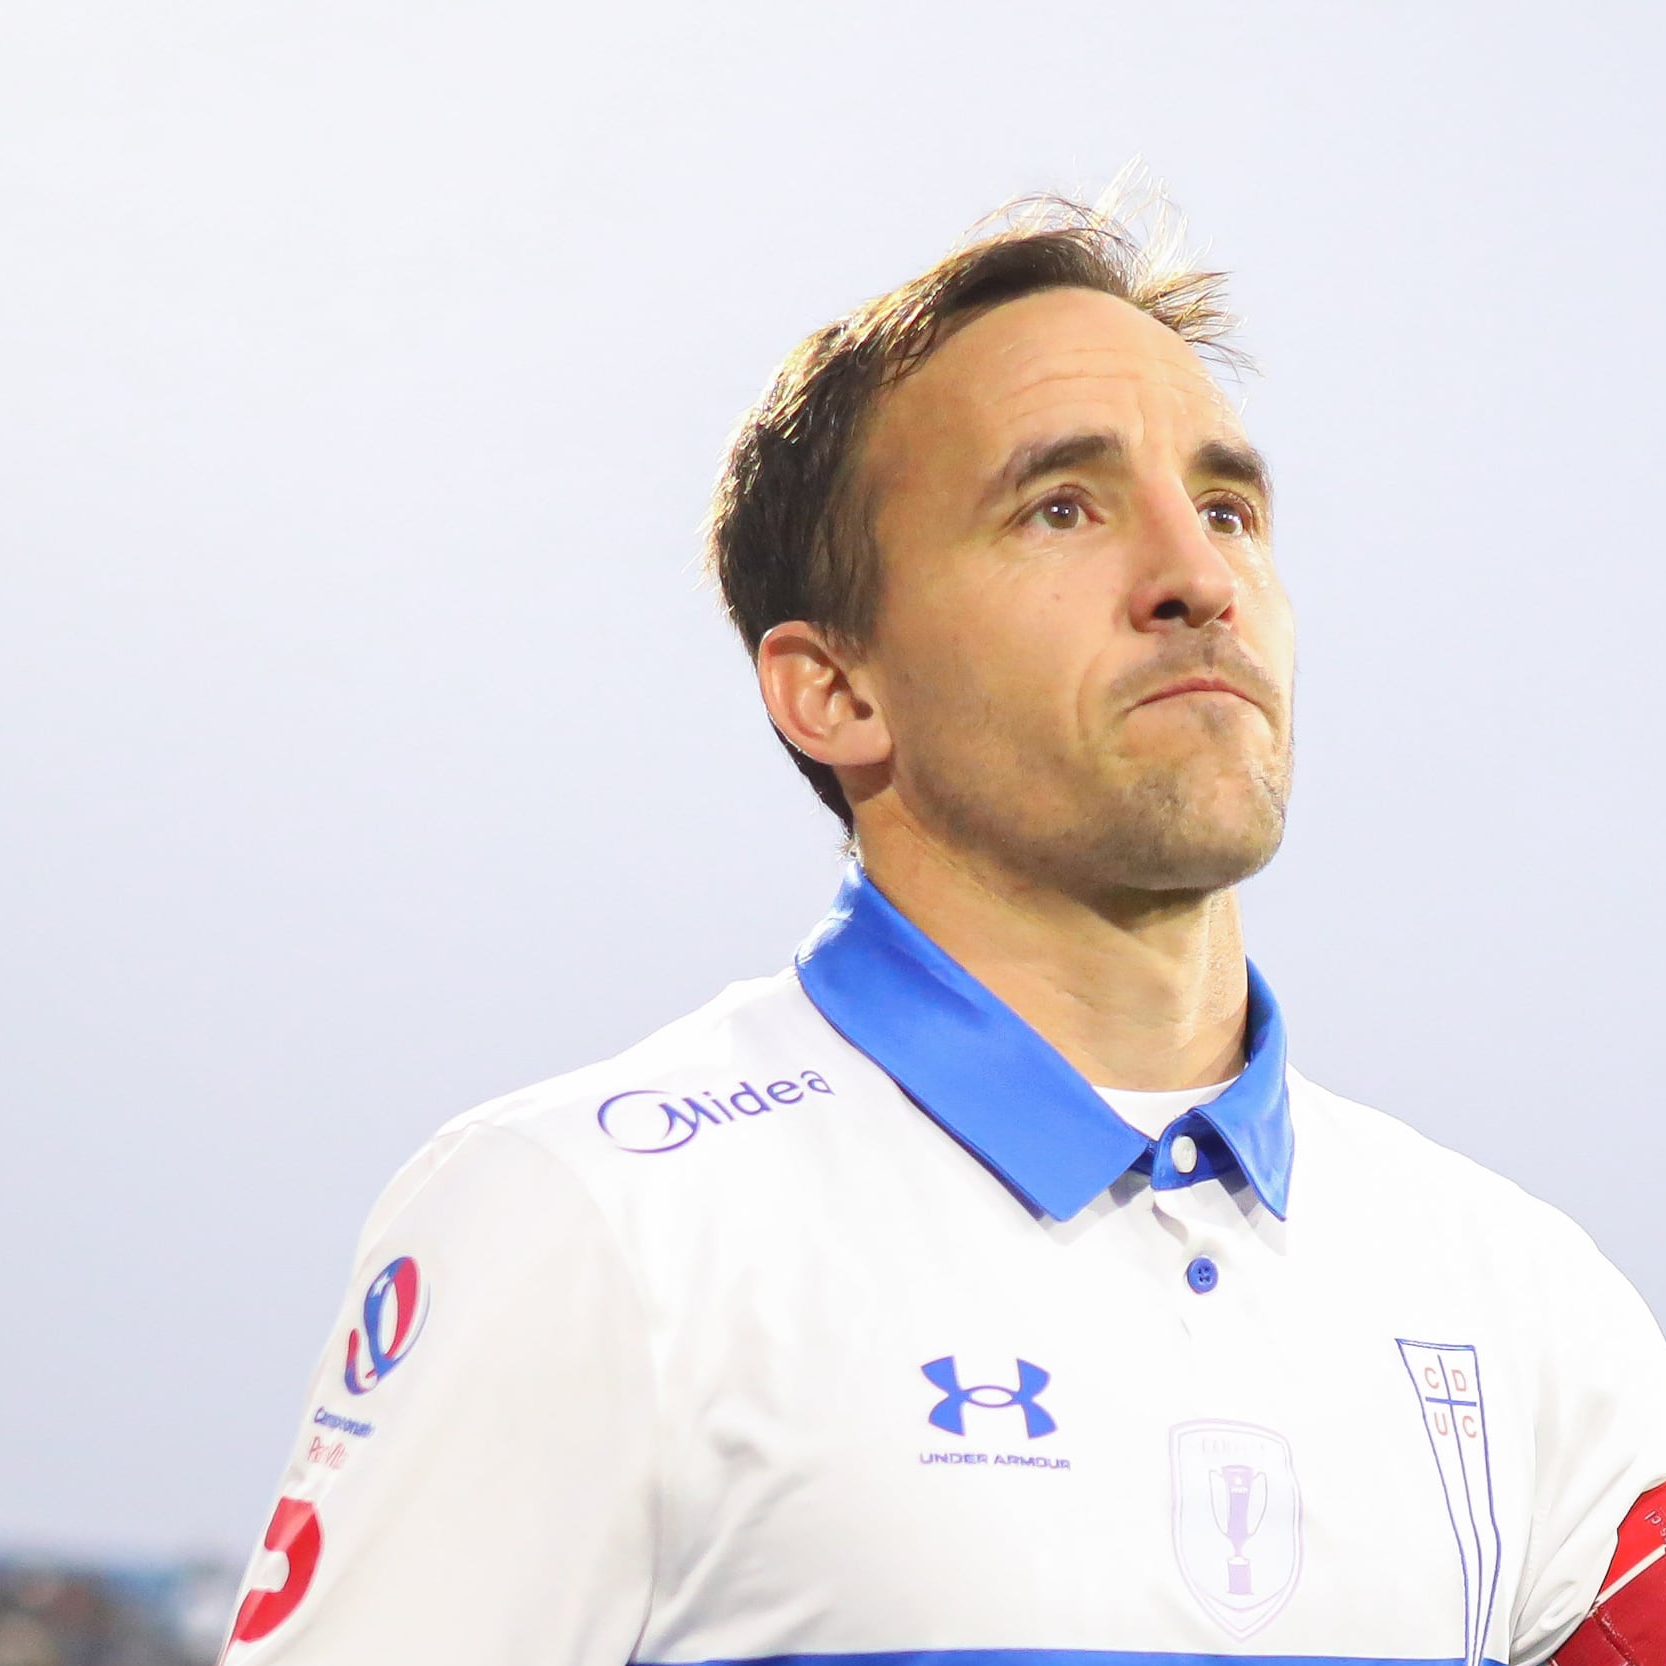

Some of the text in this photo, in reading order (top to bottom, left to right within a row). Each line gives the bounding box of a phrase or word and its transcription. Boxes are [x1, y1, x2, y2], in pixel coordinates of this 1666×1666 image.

[597, 1069, 835, 1154] Midea
[919, 1453, 1071, 1470] UNDER ARMOUR
